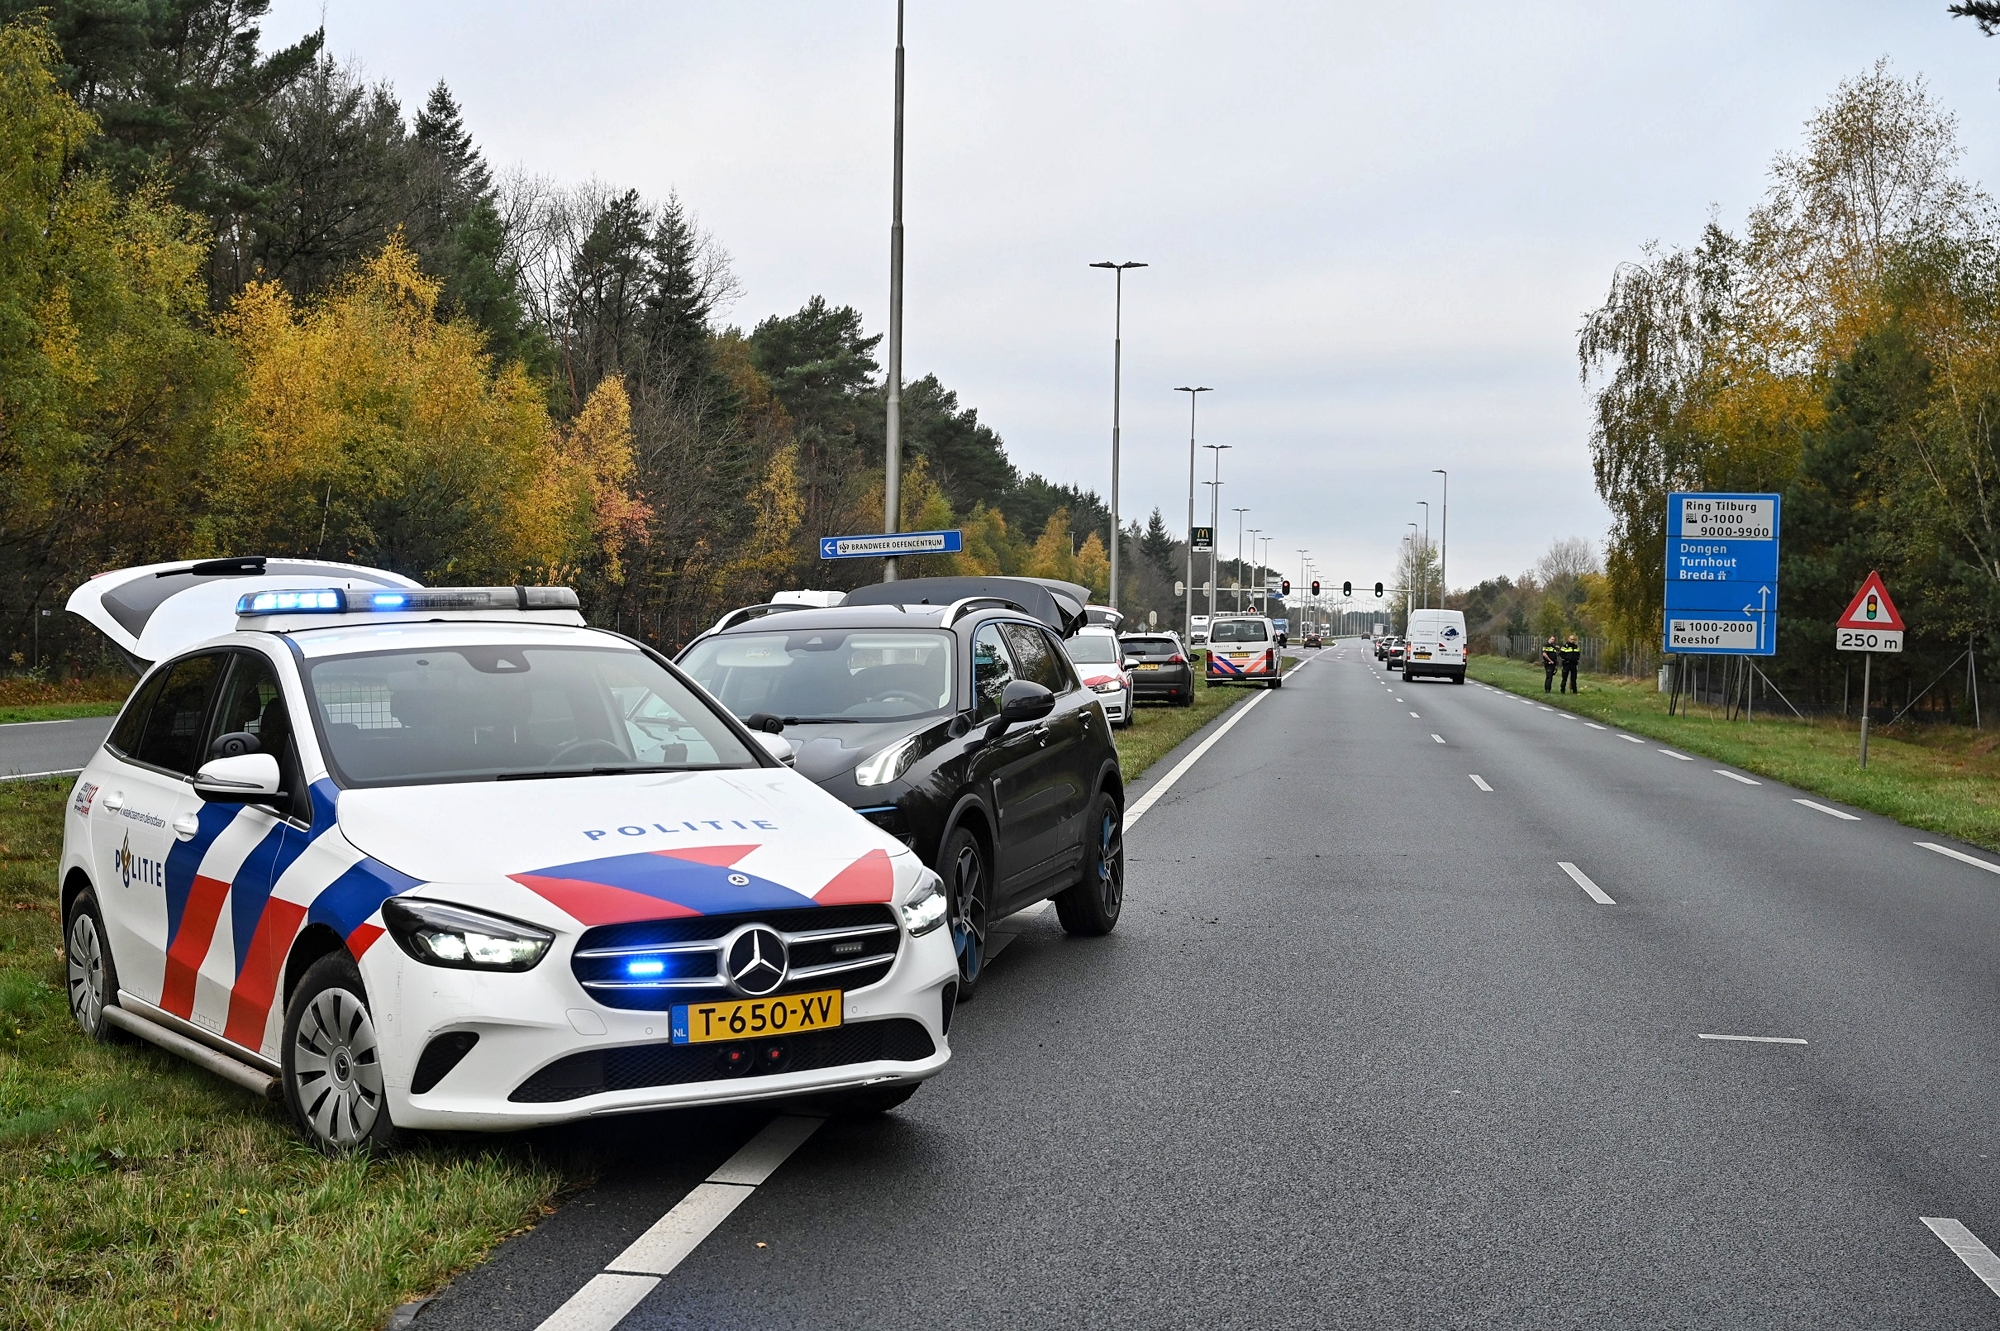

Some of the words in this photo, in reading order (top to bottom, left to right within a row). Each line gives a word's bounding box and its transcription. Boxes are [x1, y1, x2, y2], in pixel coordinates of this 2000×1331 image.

[1686, 501, 1711, 512] Ring
[1715, 502, 1757, 513] Tilburg
[1701, 514, 1743, 524] 0-1000
[1701, 526, 1769, 537] 9000-9900
[851, 541, 891, 551] BRANDWEER
[892, 539, 943, 549] OEFENCENTRUM
[1680, 543, 1727, 556] Dongen
[1680, 556, 1737, 567] Turnhout
[1680, 569, 1714, 580] Breda
[1689, 622, 1753, 633] 1000-2000
[1673, 634, 1720, 645] Reeshof
[1841, 633, 1878, 648] 250
[1884, 638, 1898, 649] m
[583, 819, 779, 841] POLITIE
[115, 849, 162, 888] POLITIE
[698, 995, 833, 1037] T-650-XV
[673, 1027, 687, 1038] NL
